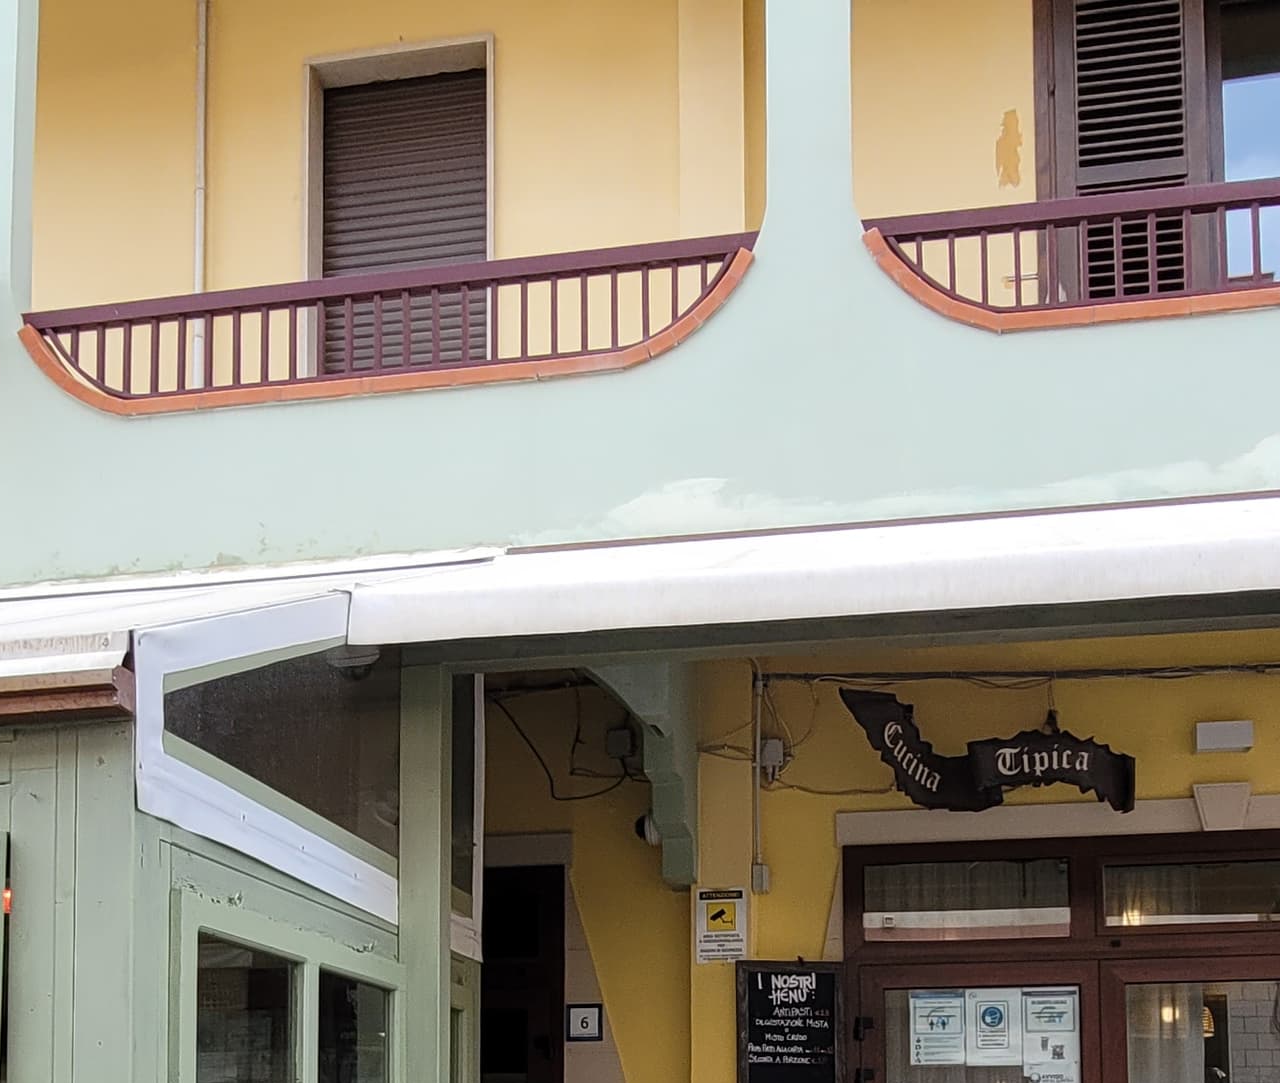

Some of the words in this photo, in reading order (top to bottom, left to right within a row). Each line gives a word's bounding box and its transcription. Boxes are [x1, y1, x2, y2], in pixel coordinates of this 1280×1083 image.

[883, 720, 942, 793] Cucina
[995, 743, 1090, 777] Tipica
[771, 972, 817, 990] NOSTRI
[772, 1006, 813, 1018] ANTIPASTI
[580, 1016, 589, 1030] 6
